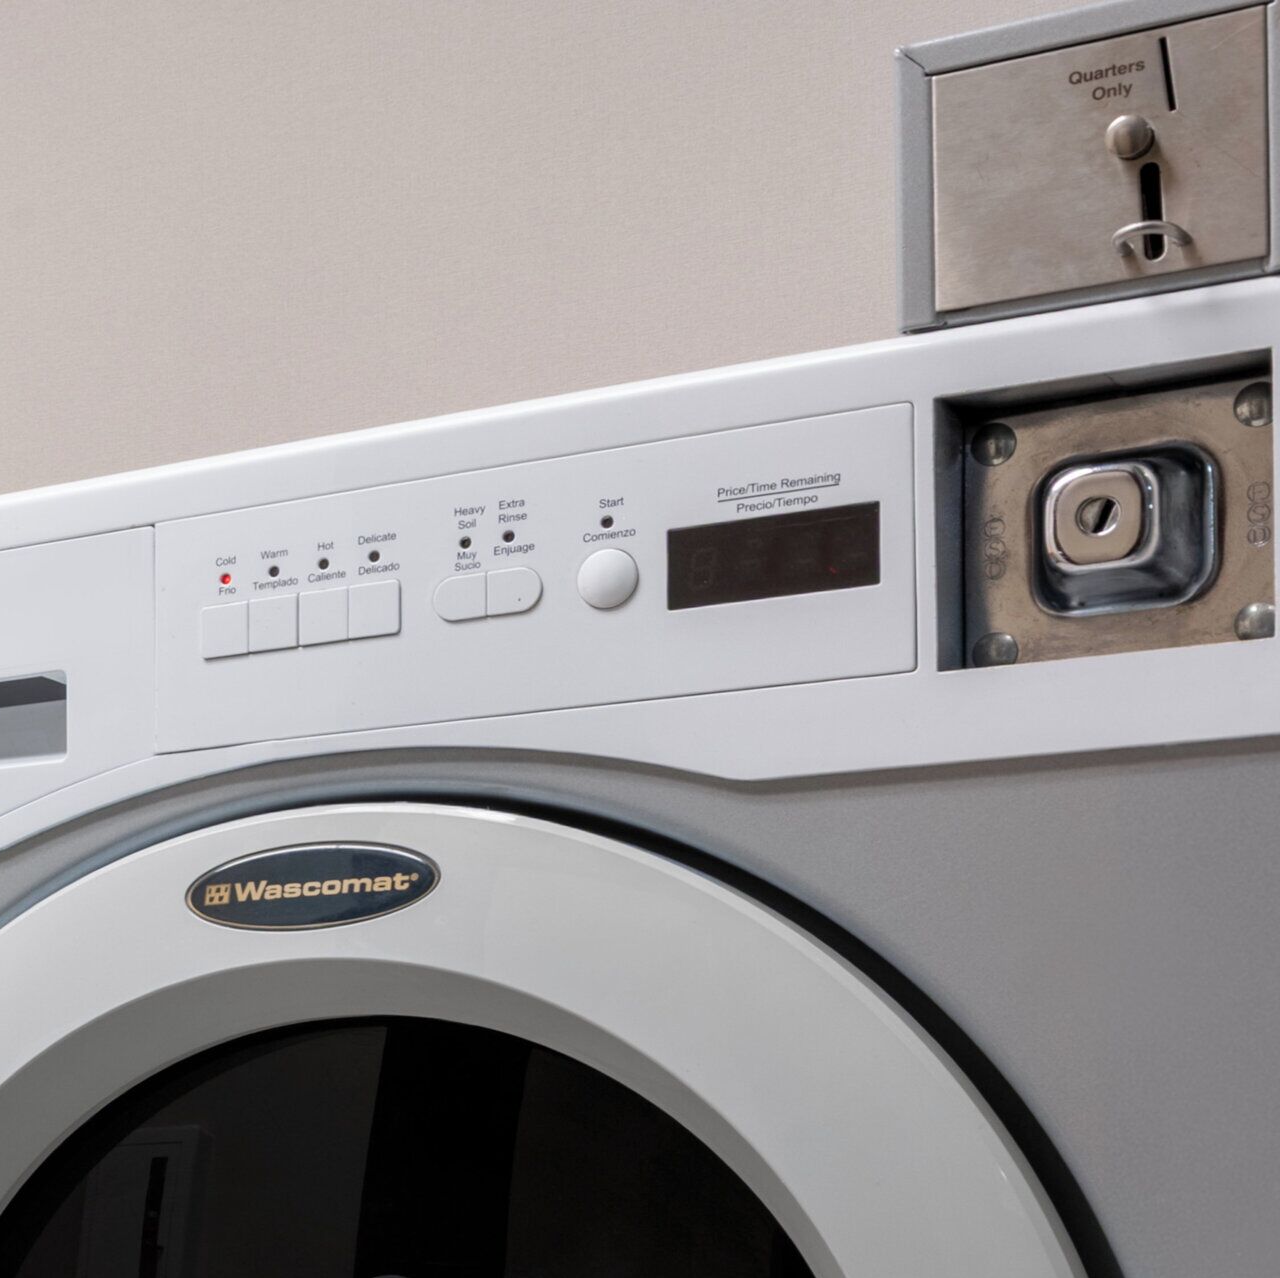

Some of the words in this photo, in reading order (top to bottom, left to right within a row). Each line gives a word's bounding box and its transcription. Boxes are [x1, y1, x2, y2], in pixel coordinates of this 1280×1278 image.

[1068, 60, 1146, 85] Quarters
[1092, 82, 1133, 101] Only
[717, 482, 777, 498] Price/Time
[780, 472, 841, 489] Remaining
[498, 498, 526, 510] Extra
[598, 496, 625, 509] Start
[736, 494, 819, 513] Precio/Tiempo
[454, 504, 486, 517] Heavy
[458, 518, 477, 530] Soil
[498, 511, 528, 524] Rinse
[357, 531, 397, 546] Delicate
[582, 528, 637, 544] Comienzo
[317, 541, 334, 552] Hot
[493, 541, 536, 558] Enjuage
[260, 548, 289, 560] Warm
[456, 550, 477, 562] Muy
[215, 555, 237, 567] Cold
[454, 560, 481, 572] Sucio
[357, 561, 400, 576] Delicado
[307, 569, 347, 584] Caliente
[218, 585, 237, 596] Frio
[252, 576, 299, 592] Templado
